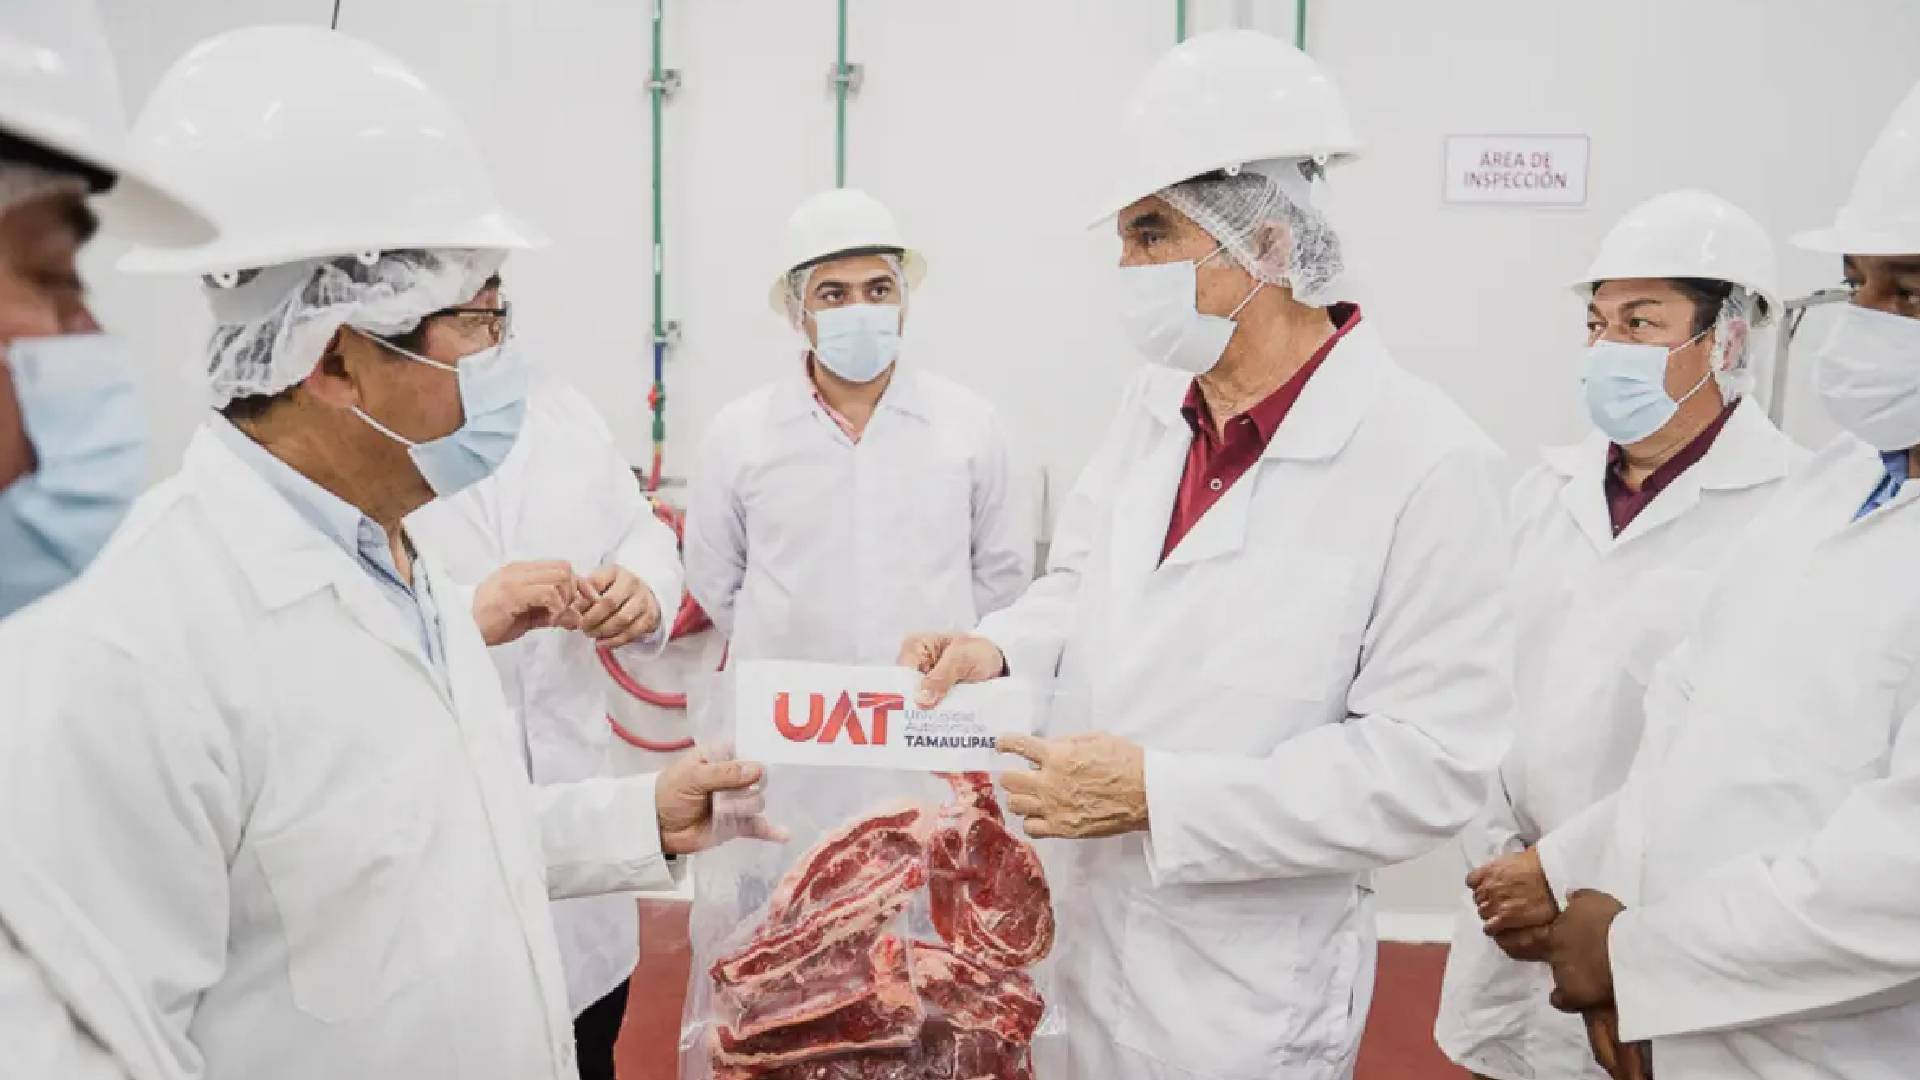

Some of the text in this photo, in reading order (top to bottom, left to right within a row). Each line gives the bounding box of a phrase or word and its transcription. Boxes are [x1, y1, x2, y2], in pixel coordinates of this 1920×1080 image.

[1531, 151, 1550, 168] DE
[1464, 170, 1567, 189] INSPECCIÓN
[774, 690, 904, 745] UAT
[904, 735, 997, 748] TAMAULIPAS
